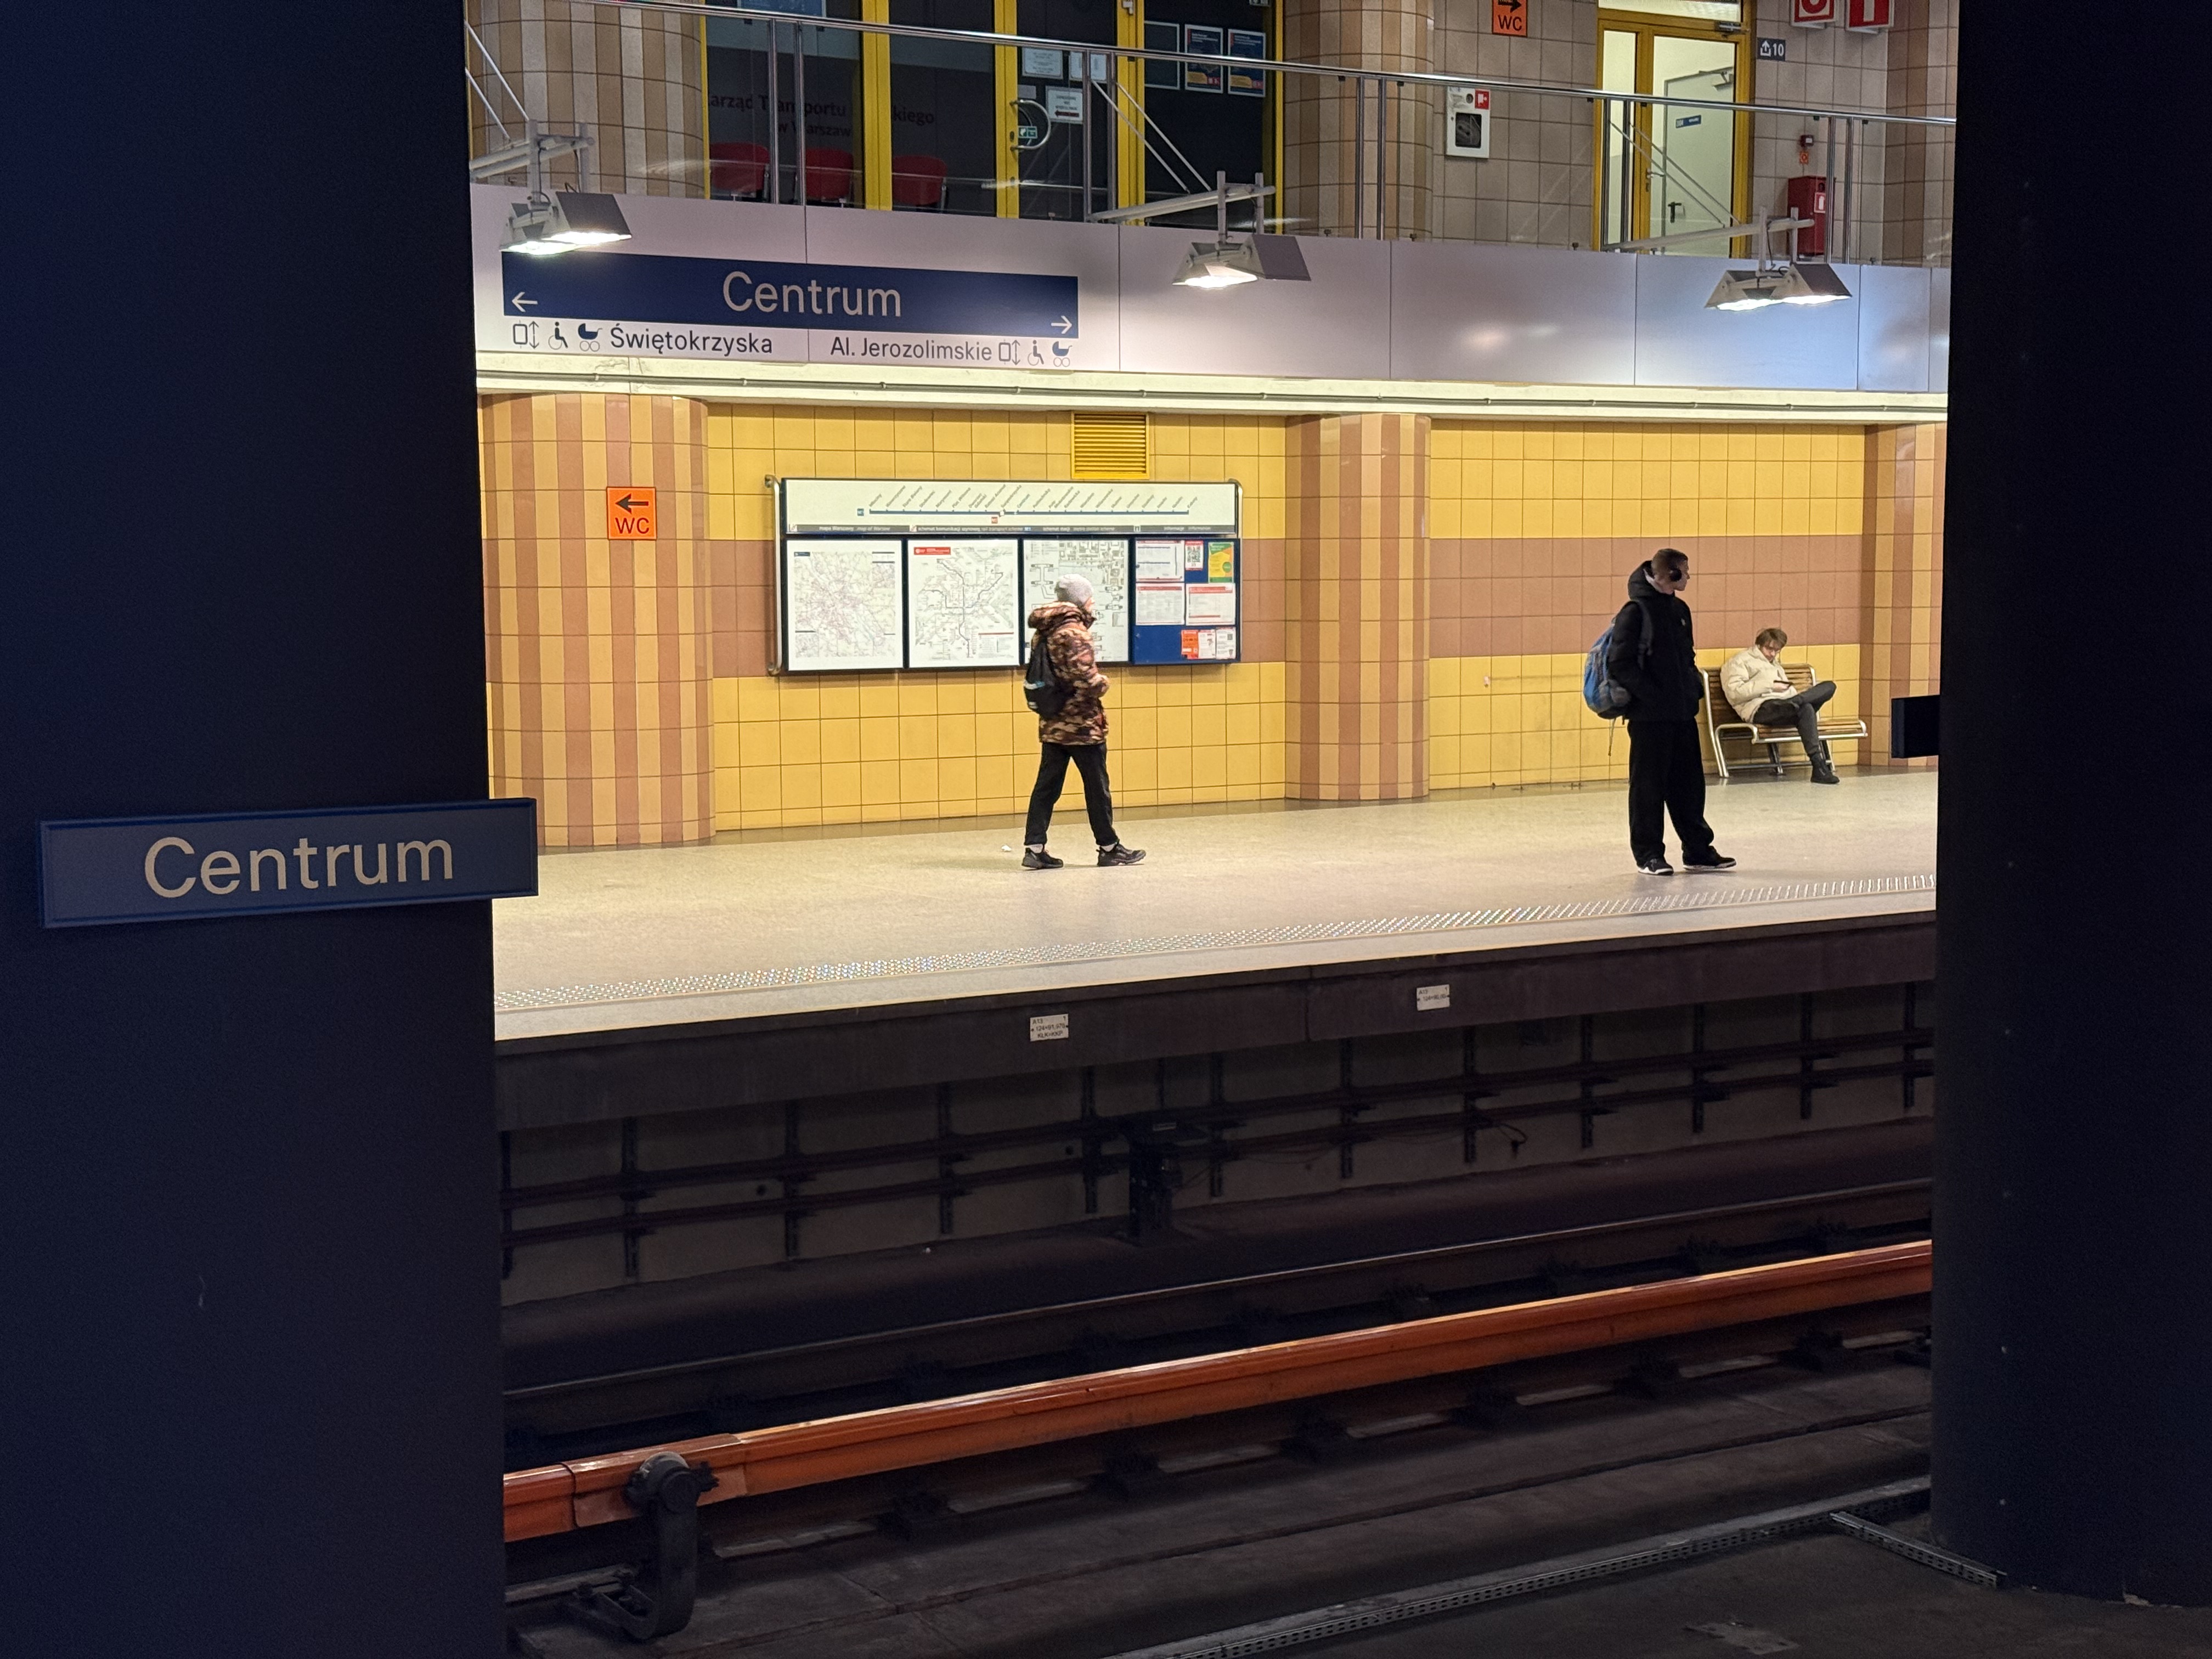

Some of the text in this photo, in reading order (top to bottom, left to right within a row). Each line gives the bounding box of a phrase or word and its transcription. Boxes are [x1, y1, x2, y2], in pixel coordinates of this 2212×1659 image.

[1498, 15, 1522, 31] WC
[1773, 43, 1784, 57] 10
[709, 94, 753, 113] arząd
[722, 270, 902, 317] Centrum
[611, 323, 773, 357] Świętokrzyska
[830, 336, 992, 361] Al. Jerozolimskie
[615, 517, 650, 534] WC
[144, 836, 453, 898] Centrum
